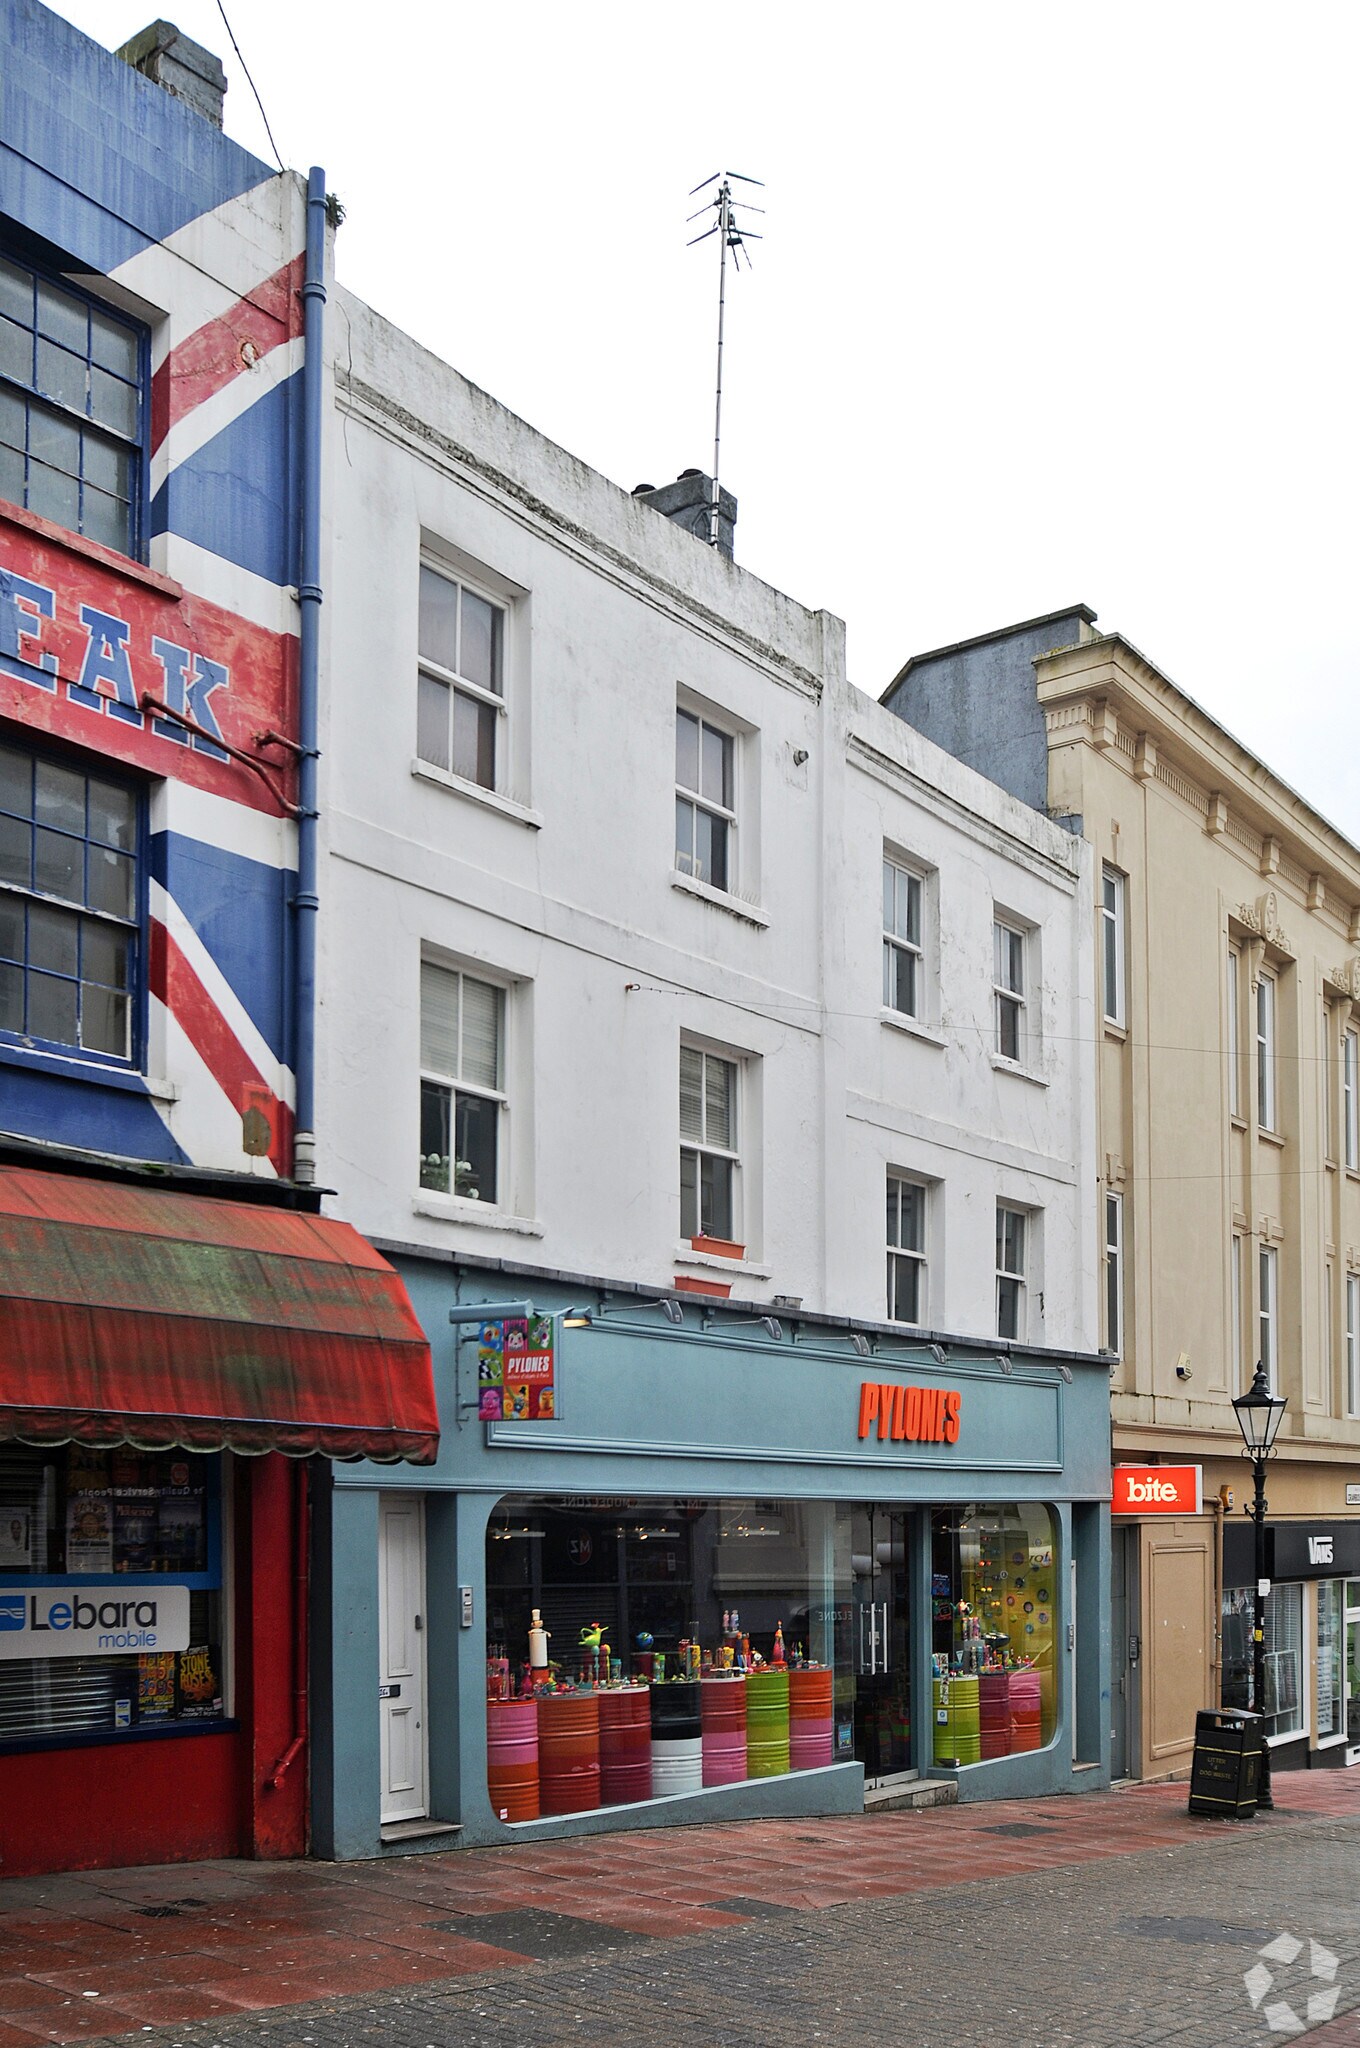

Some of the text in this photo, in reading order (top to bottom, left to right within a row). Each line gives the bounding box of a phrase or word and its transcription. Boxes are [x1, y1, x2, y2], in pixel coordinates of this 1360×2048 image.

[508, 1355, 550, 1374] PYLONES
[857, 1382, 962, 1445] PYLONES
[1308, 1536, 1334, 1565] VANS
[30, 1595, 157, 1631] Lebara
[98, 1631, 157, 1649] mobile
[180, 1653, 211, 1673] STONE
[180, 1670, 214, 1689] ROSES
[1207, 1756, 1227, 1765] LITTER
[1198, 1769, 1232, 1780] DOG WASTE
